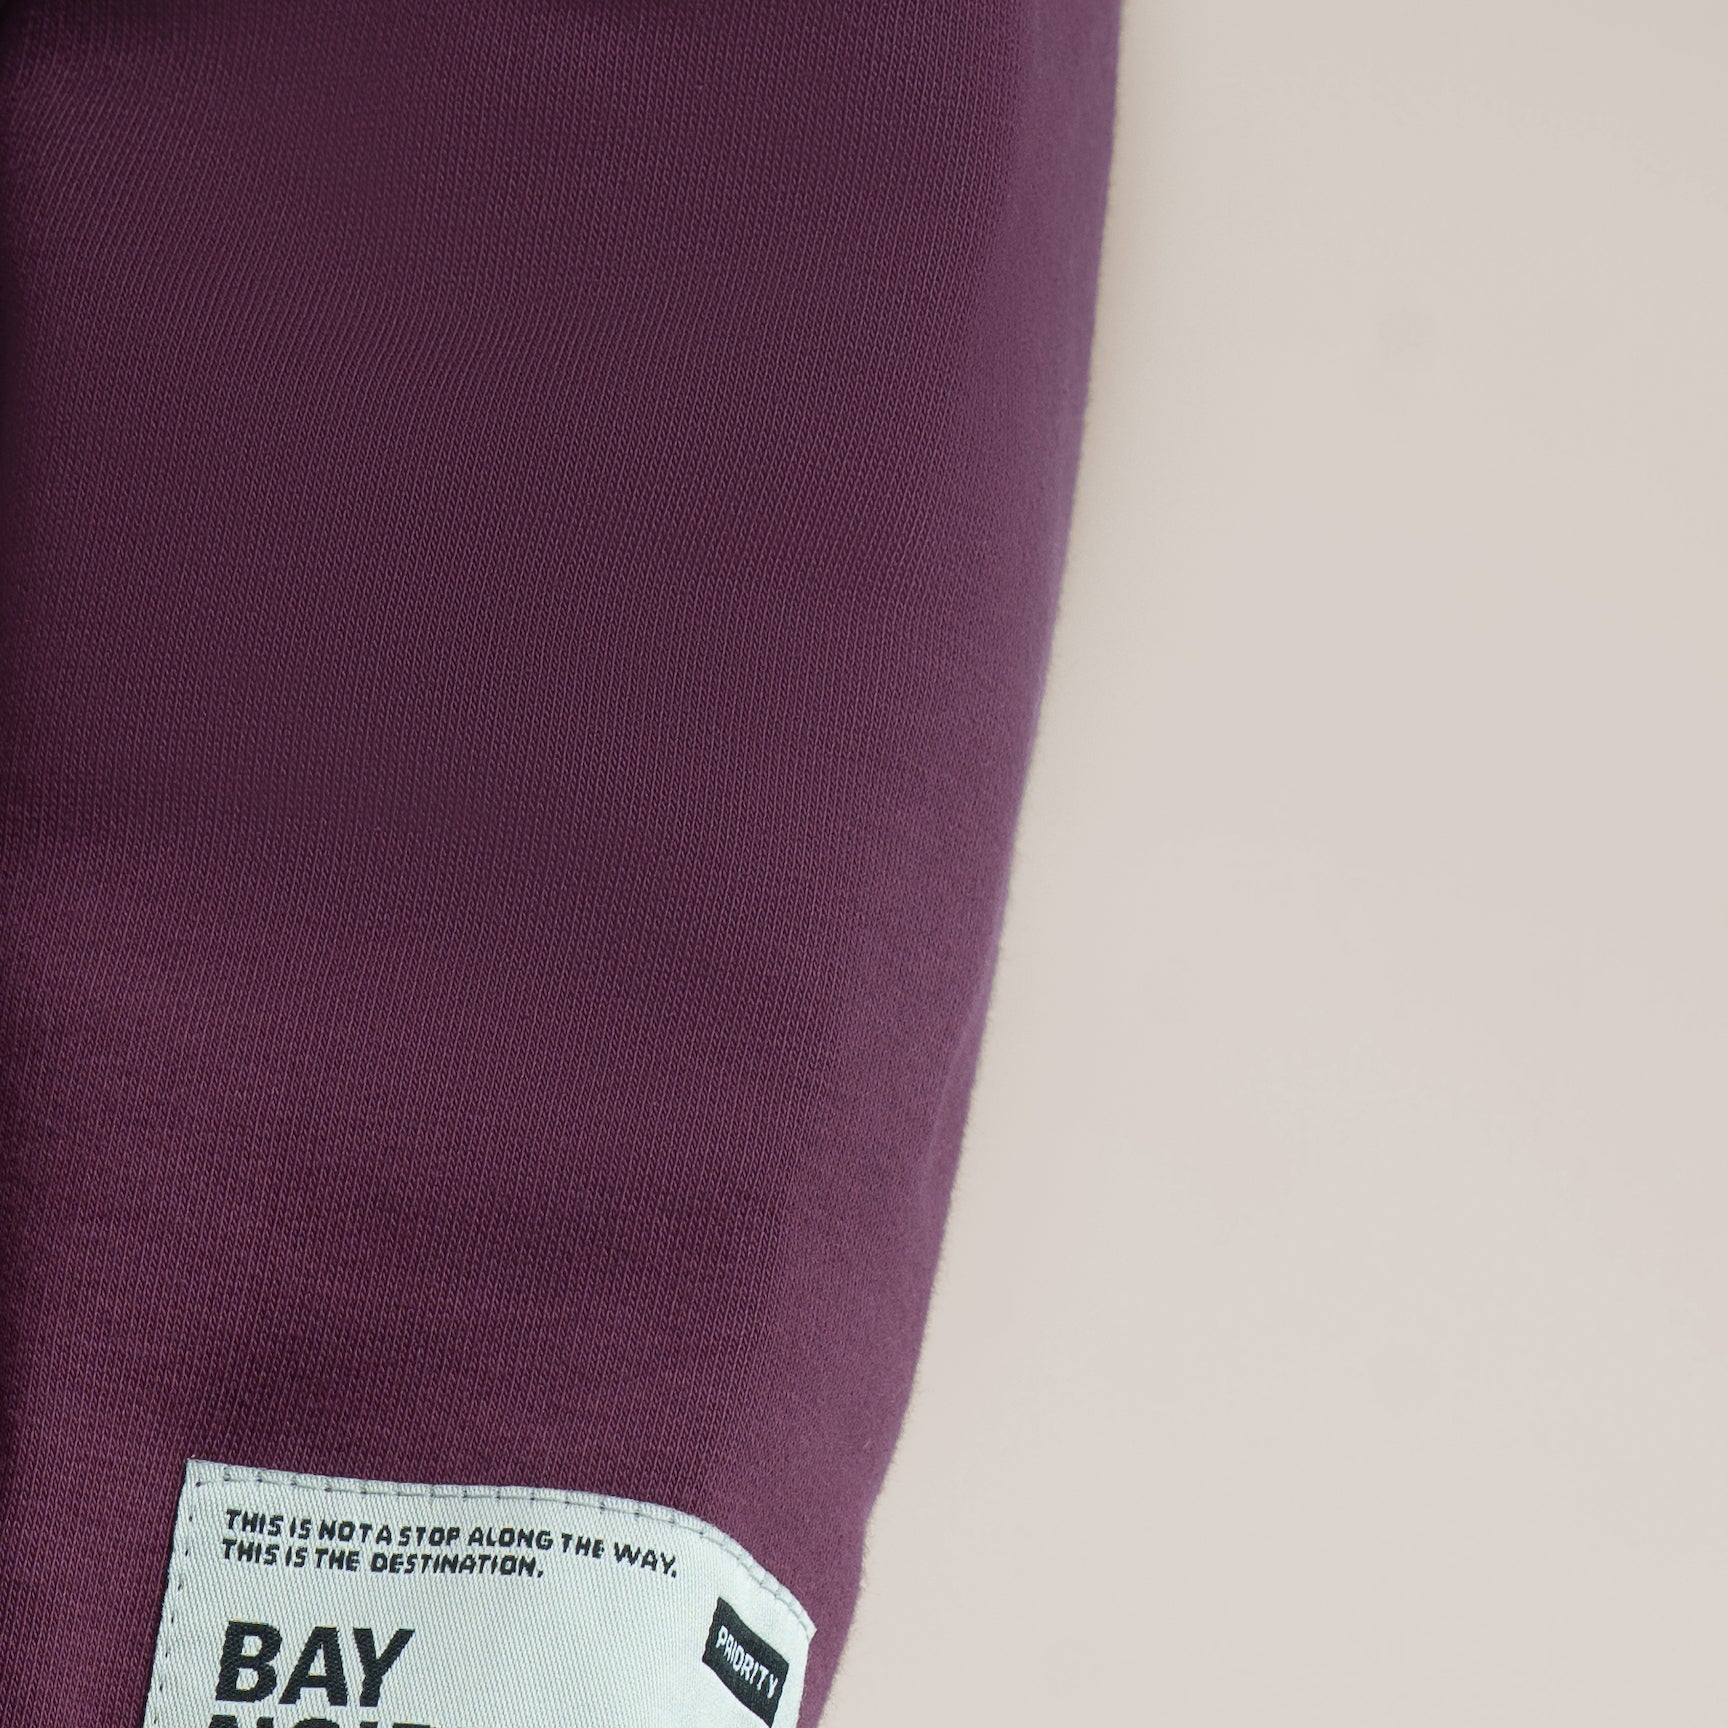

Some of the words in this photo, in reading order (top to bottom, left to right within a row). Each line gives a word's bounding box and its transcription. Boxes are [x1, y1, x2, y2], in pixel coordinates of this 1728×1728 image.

[223, 1538, 281, 1567] THIS
[286, 1546, 309, 1569] IS
[315, 1549, 362, 1573] THE
[226, 1510, 285, 1538] THIS
[290, 1518, 313, 1541] IS
[319, 1521, 374, 1545] NOT
[376, 1525, 394, 1547] A
[398, 1527, 462, 1548] STOP
[468, 1527, 555, 1552] ALONG
[562, 1534, 606, 1560] THE
[615, 1543, 678, 1578] WAY.
[216, 1621, 417, 1709] BAY
[715, 1625, 778, 1699] PRIORITY
